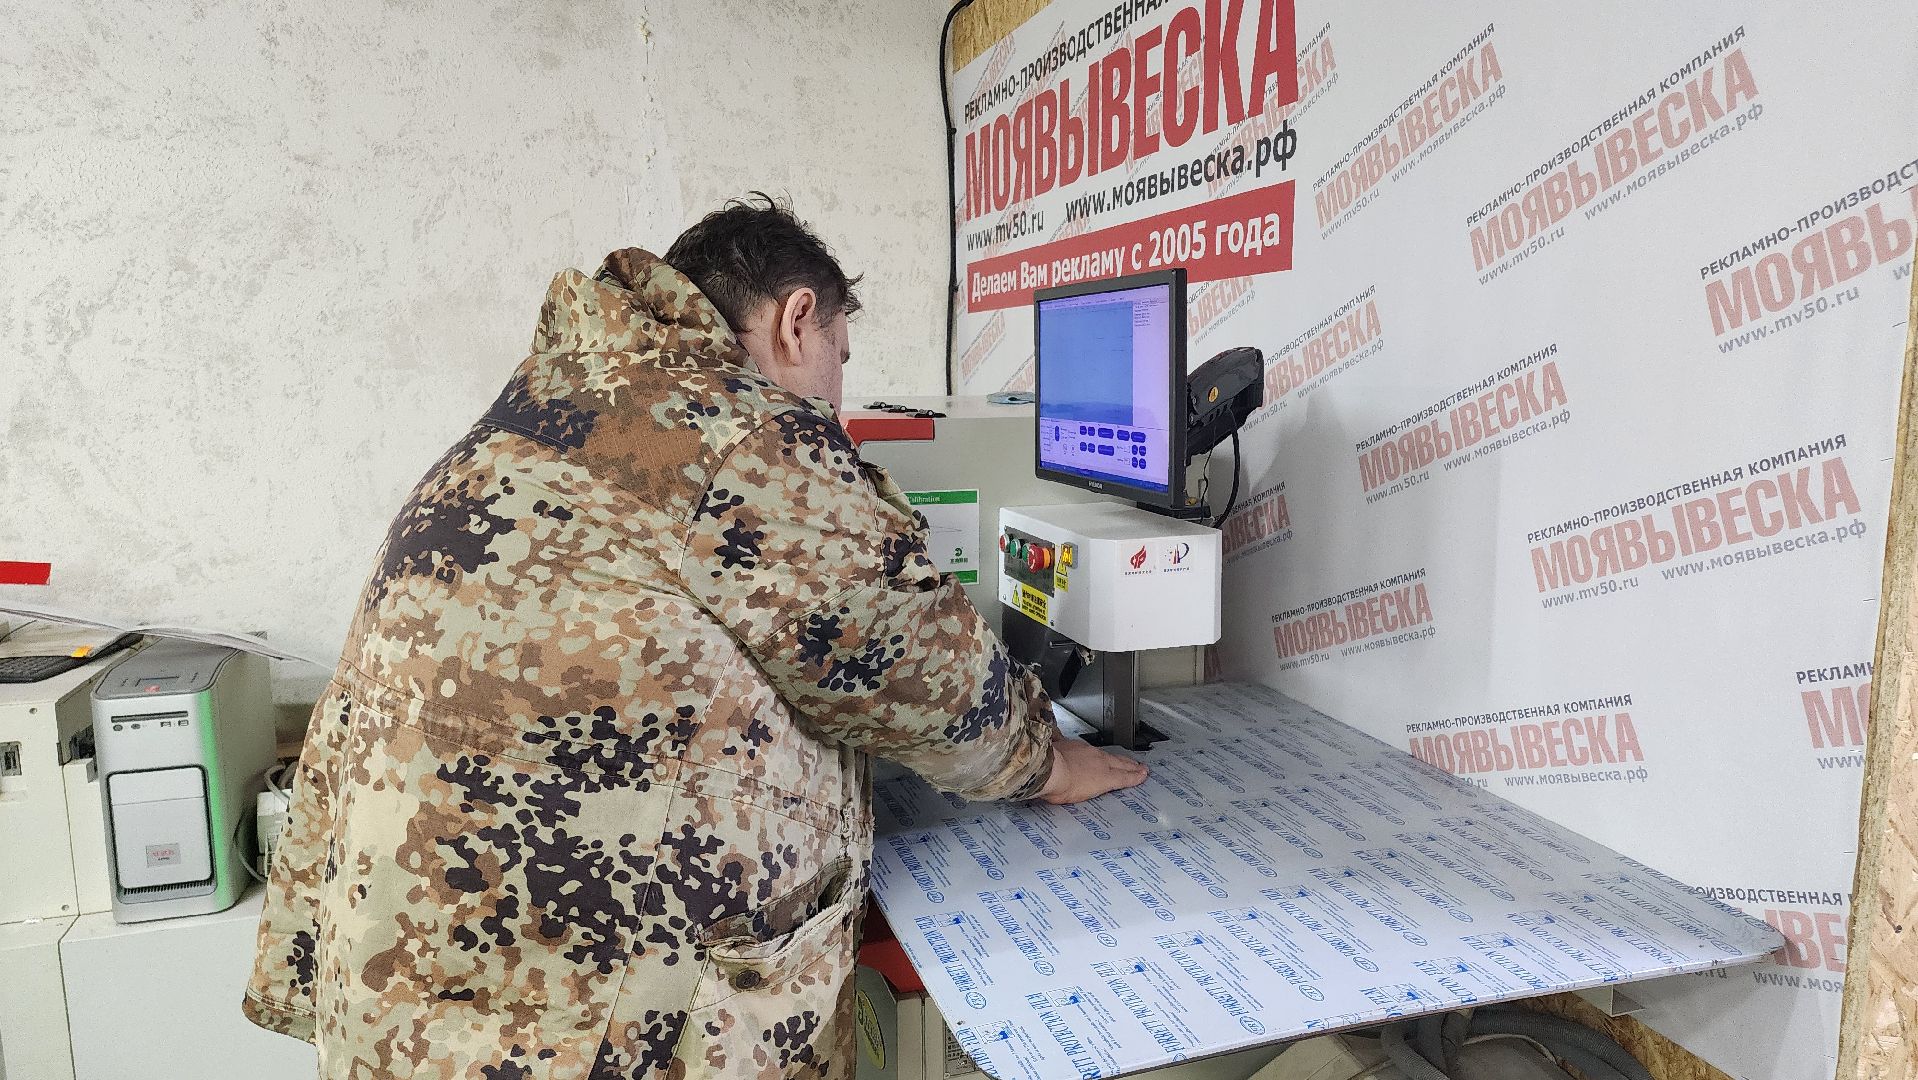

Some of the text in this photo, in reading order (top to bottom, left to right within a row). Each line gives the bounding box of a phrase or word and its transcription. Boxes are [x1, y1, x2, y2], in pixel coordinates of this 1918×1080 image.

[1296, 21, 1331, 64] ОМПАНИЯ
[966, 0, 1298, 221] МОЯВЫВЕСКА
[1312, 73, 1438, 192] РЕКЛАМНО-ПРОИЗВОДСТВЕННАЯ
[1440, 22, 1495, 77] КОМПАНИЯ
[1314, 41, 1504, 229] МОЯВЫВЕСКА
[1466, 25, 1746, 227] РЕКЛАМНО-ПРОИЗВОДСТВЕННАЯ КОМПАНИЯ
[967, 209, 1044, 252] www.mv50.ru
[1066, 120, 1298, 223] www.моявывеска.рф
[1321, 83, 1506, 240] www.mv50.ru www.моявывеска.рф
[1469, 48, 1759, 272] МОЯВЫВЕСКА
[1479, 103, 1763, 286] www.mv50.ru www.моявывеска.рф
[972, 211, 1280, 302] Делаем Вам рекламу с 2005 года
[1333, 284, 1376, 320] КОМПАНИЯ
[1258, 299, 1382, 411] ЯВЫВЕСКА
[1718, 286, 1860, 354] www.mv50.ru
[1355, 343, 1558, 452] РЕКЛАМНО-ПРОИЗВОДСТВЕННАЯ КОМПАНИЯ
[1358, 360, 1568, 493] МОЯВЫВЕСКА
[1365, 408, 1571, 505] www.mv50.ru www.моявывеска.рф
[1527, 433, 1847, 544] РЕКЛАМНО-ПРОИЗВОДСТВЕННАЯ КОМПАНИЯ
[1531, 456, 1862, 593] МОЯВЫВЕСКА
[1541, 518, 1867, 609] www.mv50.ru www.моявывеска.рф
[1271, 567, 1426, 623] РЕКЛАМНО-ПРОИЗВОДСТВЕННАЯ КОМПАНИЯ
[1273, 582, 1434, 660] МОЯВЫВЕСКА
[1279, 624, 1437, 671] www.mv50.ru www.моявывеска.рф
[1406, 694, 1633, 734] РЕКЛАМНО-ПРОИЗВОДСТВЕННАЯ КОМПАНИЯ
[1408, 712, 1645, 776] МОЯВЫВЕСКА
[1504, 765, 1648, 787] www.моявывеска.рф
[1434, 975, 1479, 1001] ECTION
[1583, 961, 1621, 979] RETT
[968, 1047, 1004, 1080] ECTION
[1070, 1055, 1103, 1078] RETT
